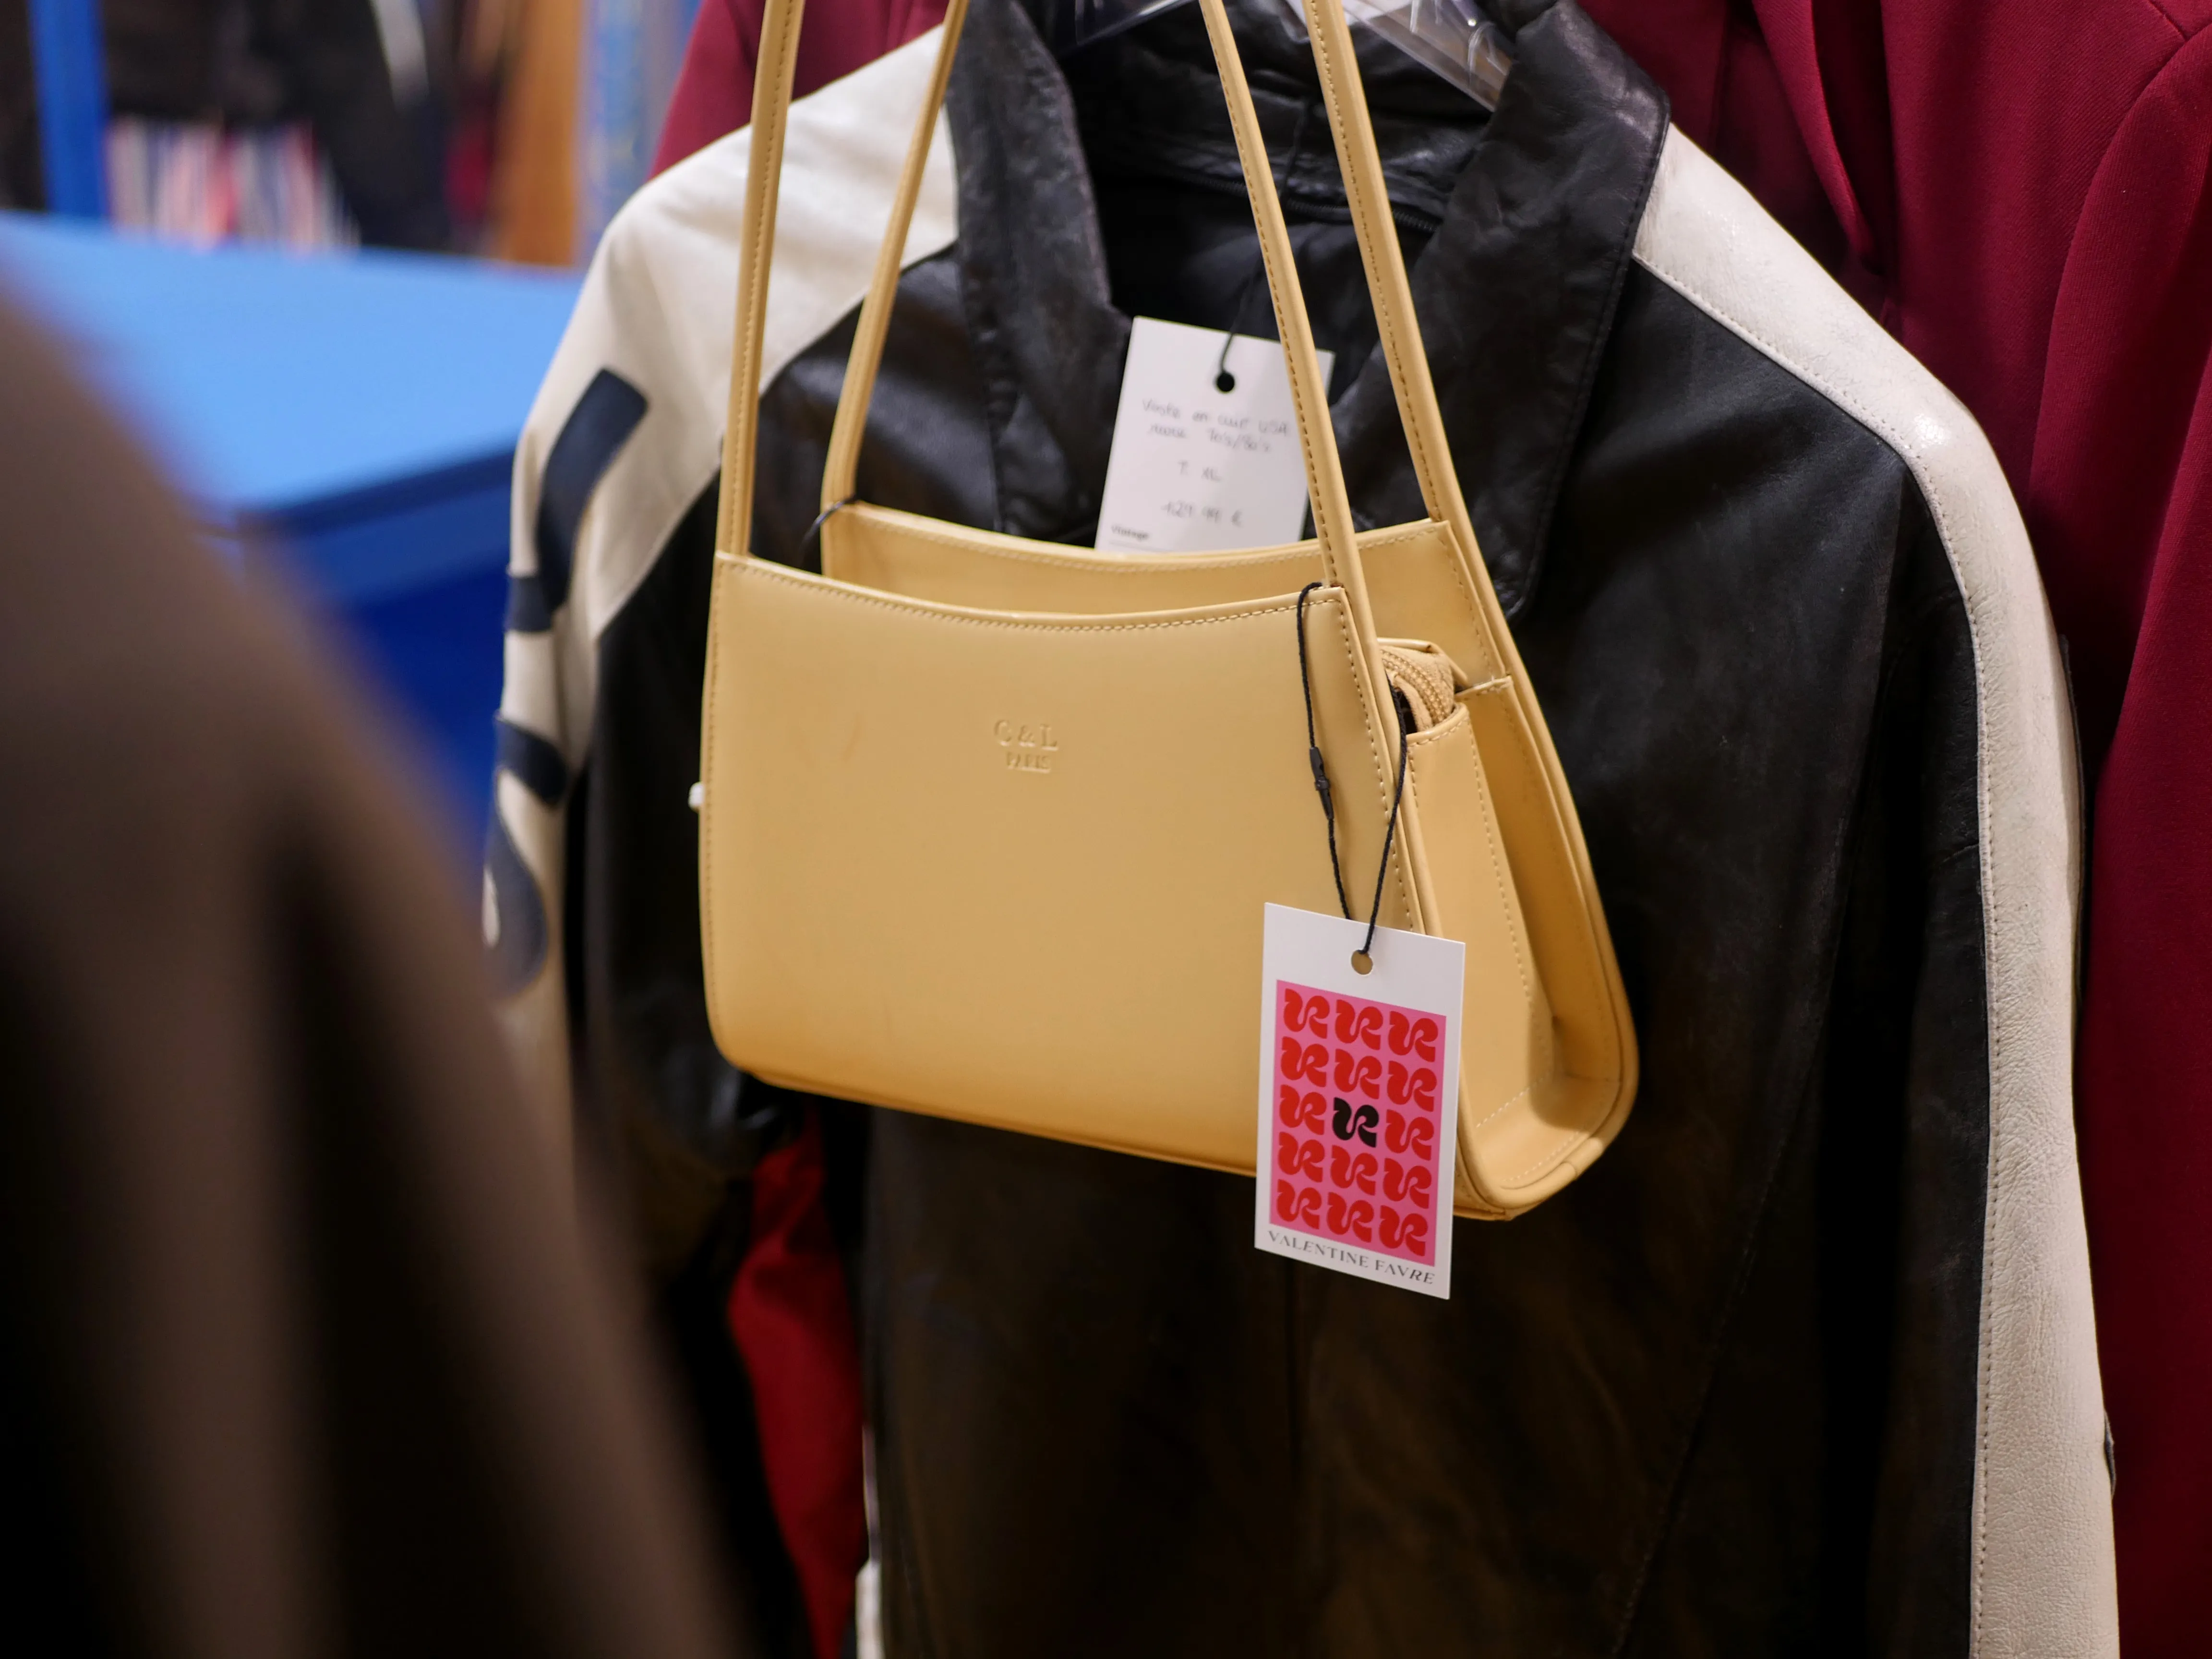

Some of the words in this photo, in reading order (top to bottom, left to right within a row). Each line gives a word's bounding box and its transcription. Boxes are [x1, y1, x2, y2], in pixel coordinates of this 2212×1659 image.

[1258, 419, 1290, 437] USA
[1268, 1230, 1369, 1269] VALENTINE
[1375, 1259, 1435, 1285] FAVRE
